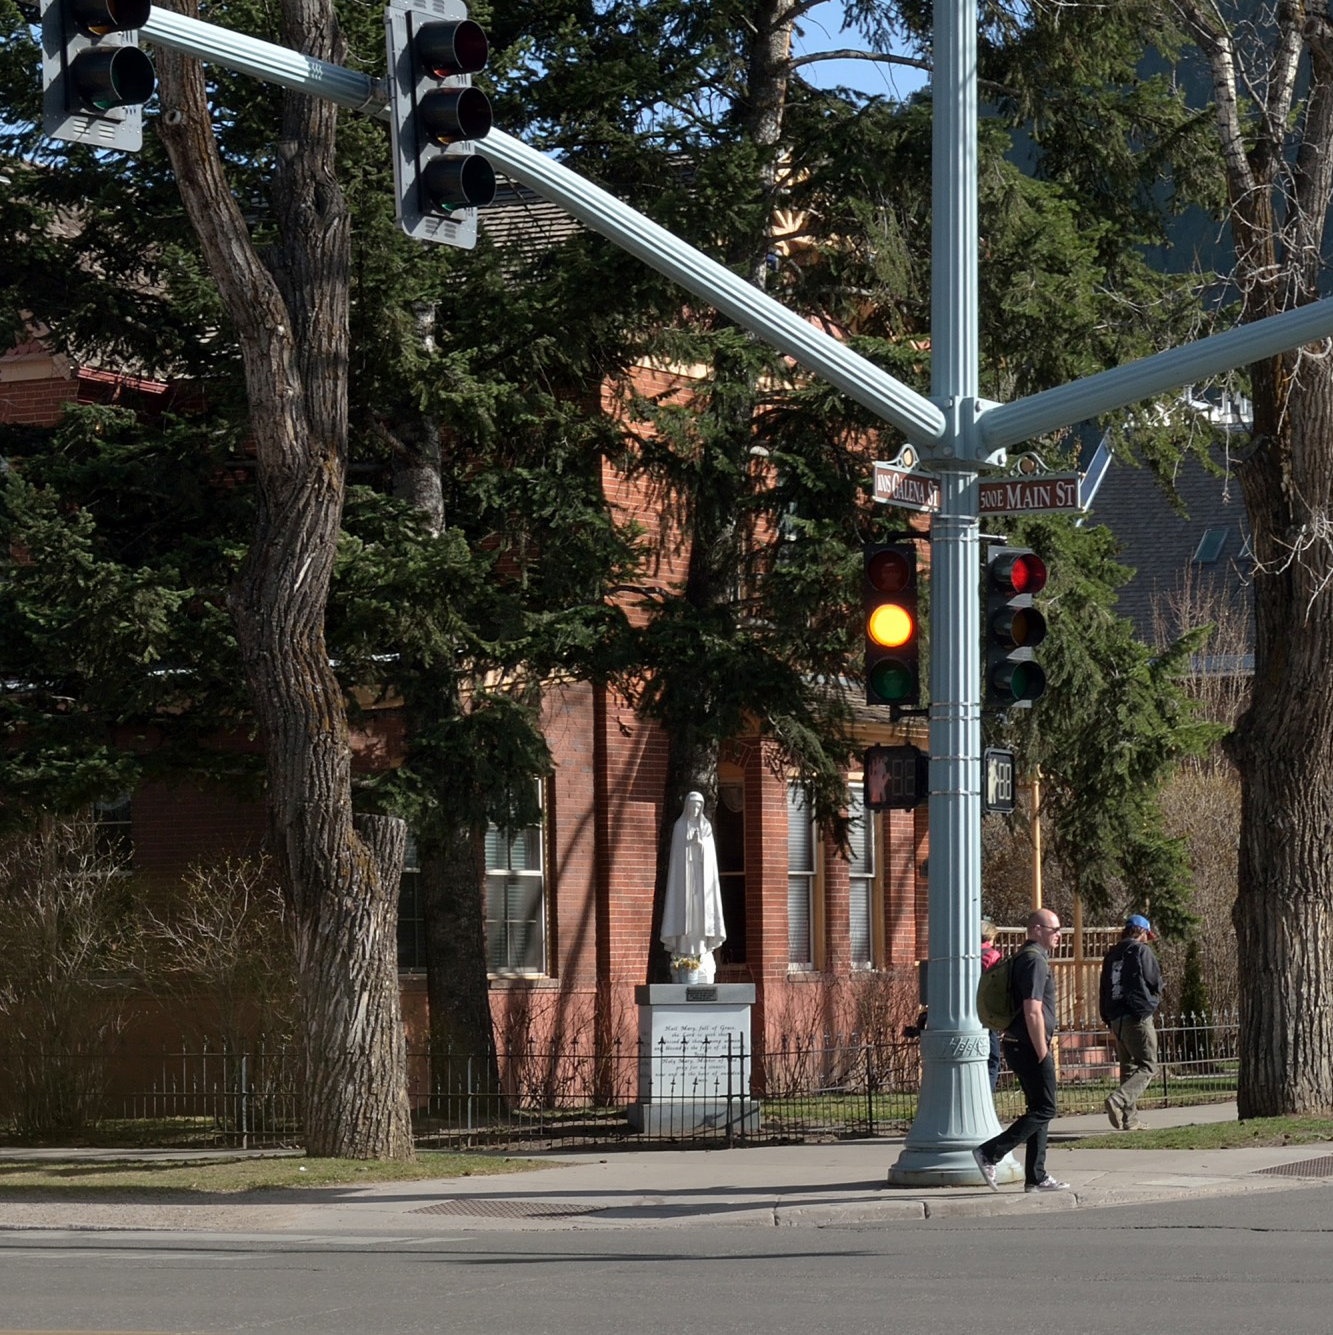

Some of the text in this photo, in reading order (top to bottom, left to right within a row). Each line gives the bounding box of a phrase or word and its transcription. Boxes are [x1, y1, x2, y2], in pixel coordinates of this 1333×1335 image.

[892, 473, 925, 504] GALENA
[927, 480, 939, 507] ST
[980, 481, 1075, 510] 500E MAIN ST
